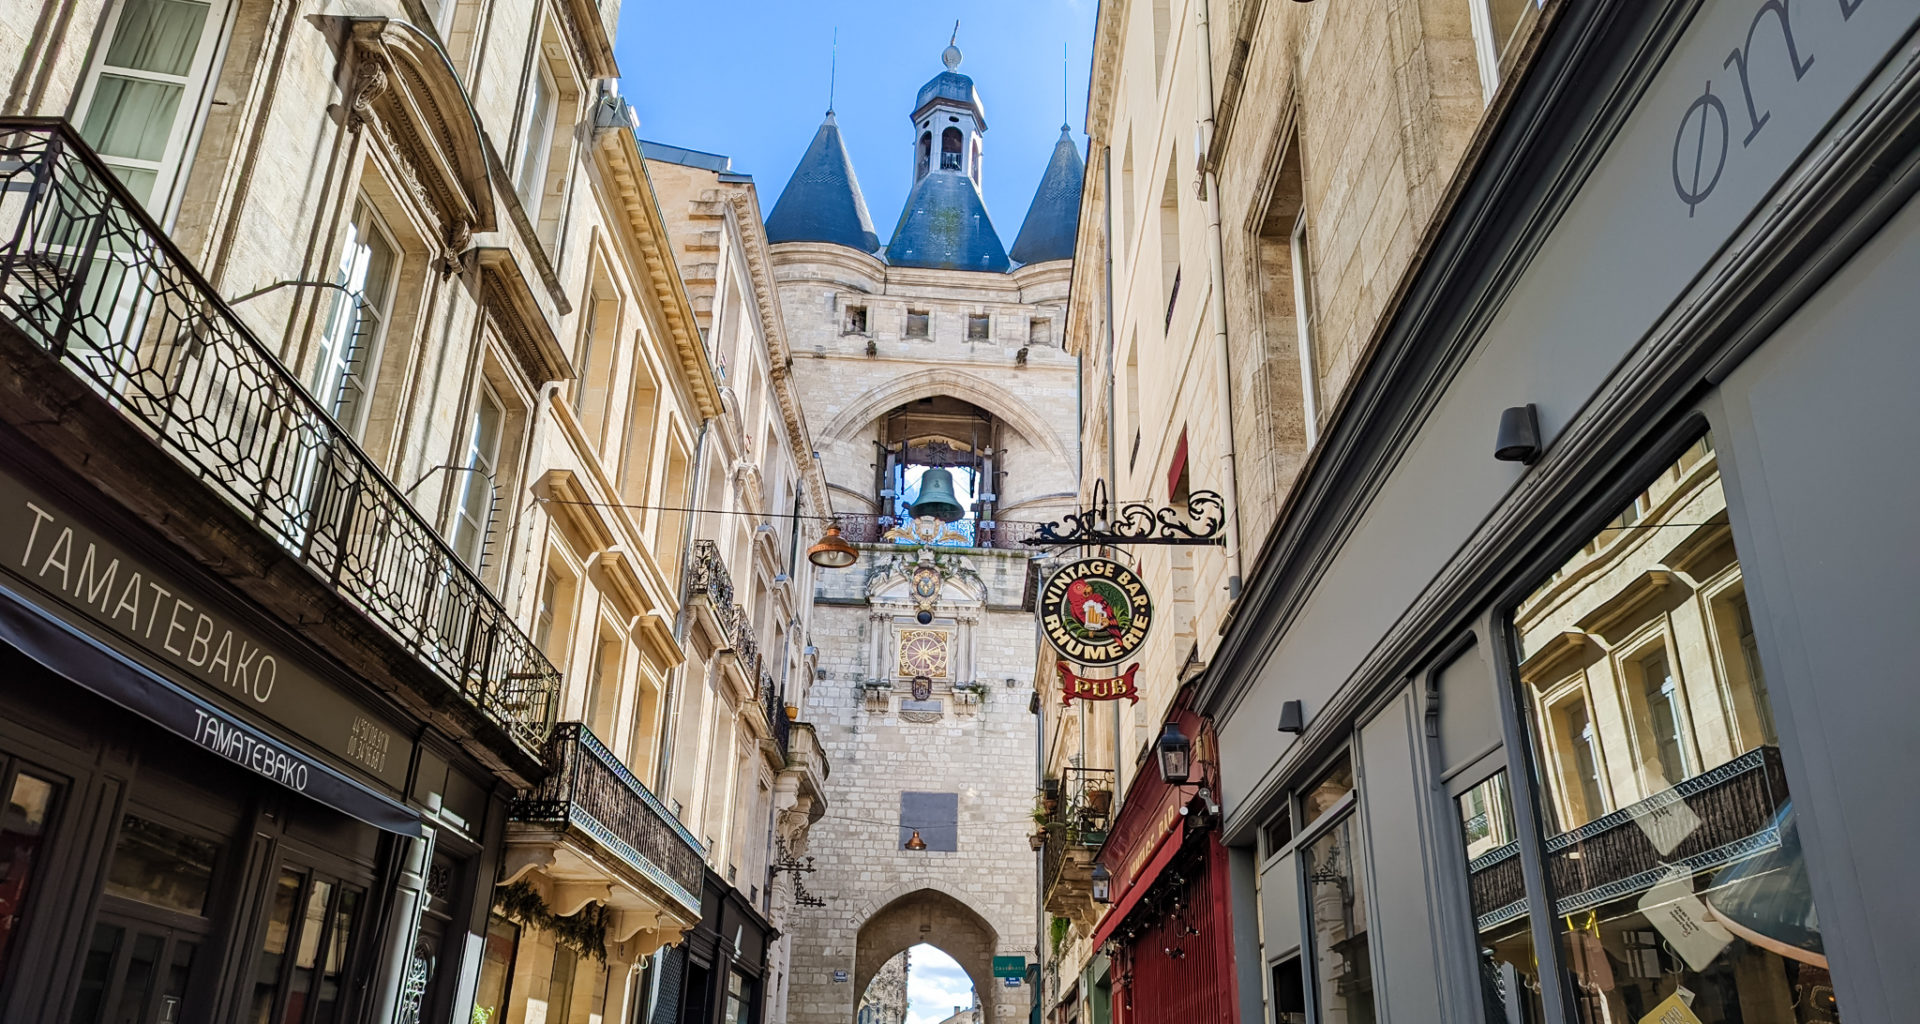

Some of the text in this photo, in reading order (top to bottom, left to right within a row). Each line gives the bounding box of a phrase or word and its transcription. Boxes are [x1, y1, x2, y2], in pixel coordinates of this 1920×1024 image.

[21, 502, 277, 703] TAMATEBAKO
[1045, 561, 1148, 608] VINTAGE BAR
[1044, 614, 1149, 660] RHUMERIE
[1074, 678, 1127, 697] PUB
[194, 709, 308, 791] TAMATEBAKO
